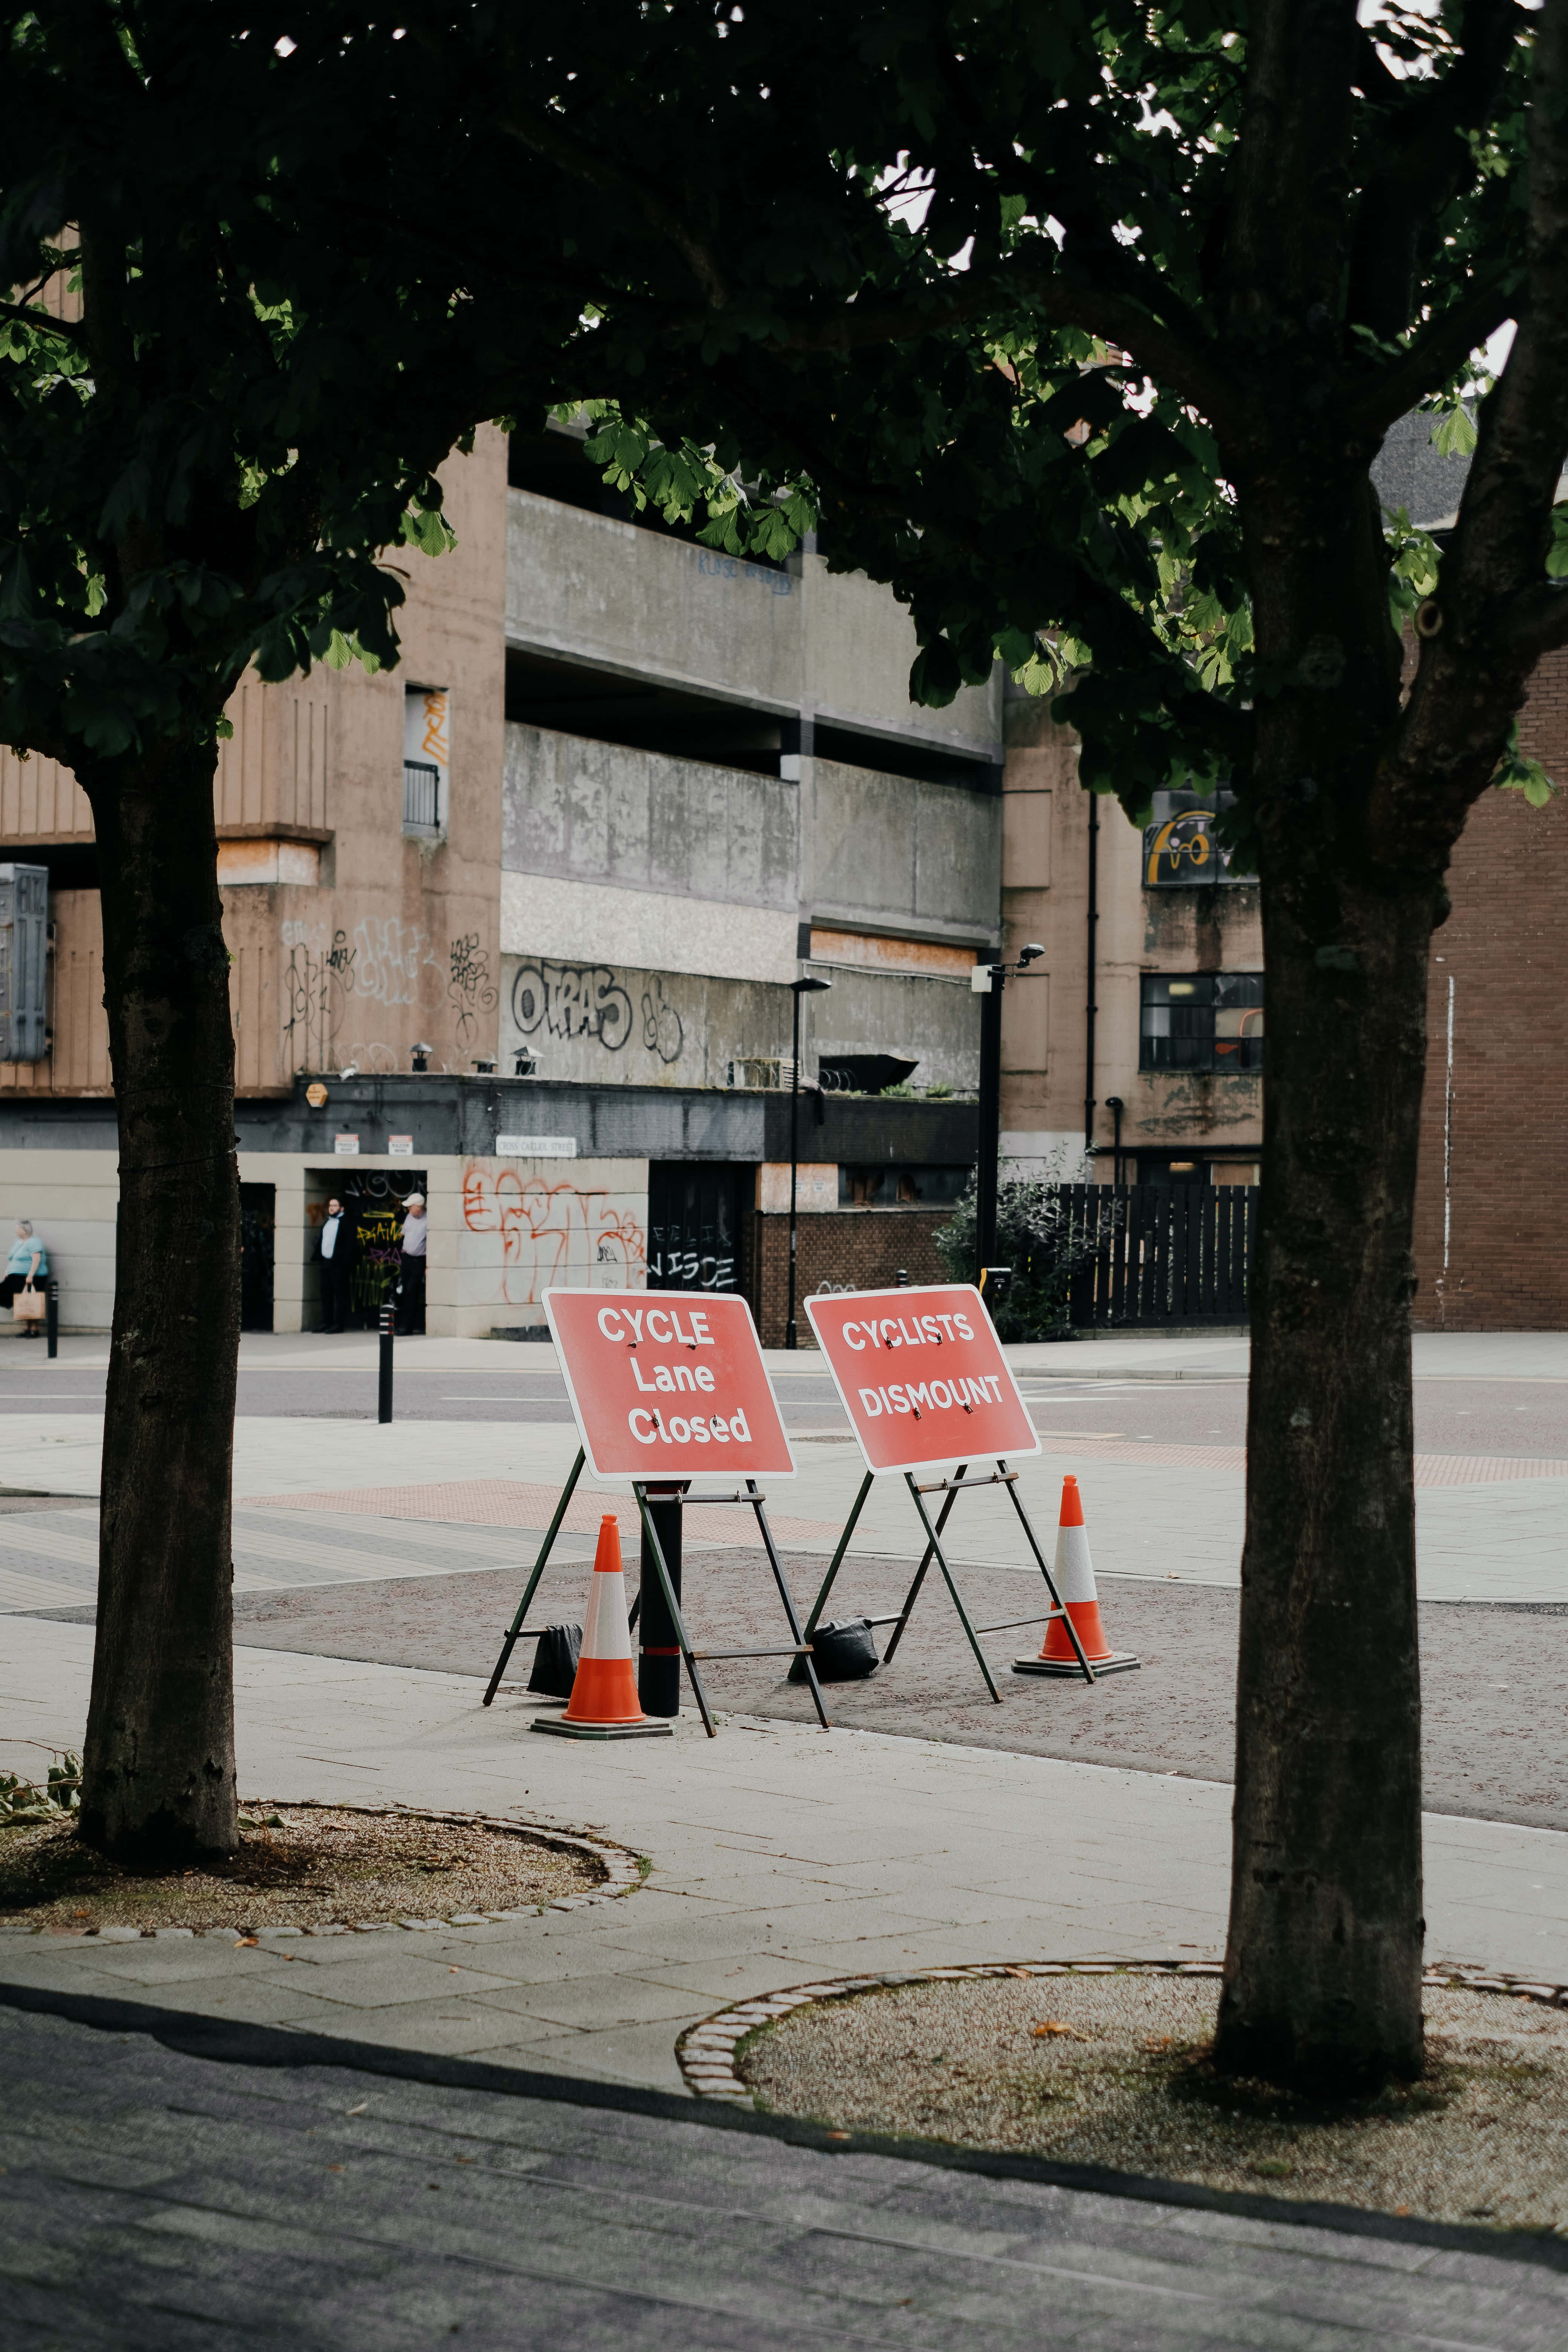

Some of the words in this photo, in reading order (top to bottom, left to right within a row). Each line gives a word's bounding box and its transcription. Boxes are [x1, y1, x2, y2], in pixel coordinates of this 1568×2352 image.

[498, 1142, 518, 1150] CROSS
[550, 1143, 574, 1152] STREET
[597, 1308, 715, 1346] CYCLE
[842, 1313, 974, 1350] CYCLISTS
[629, 1357, 715, 1392] Lane
[858, 1375, 1003, 1417] DISMOUNT
[628, 1408, 752, 1444] Closed
